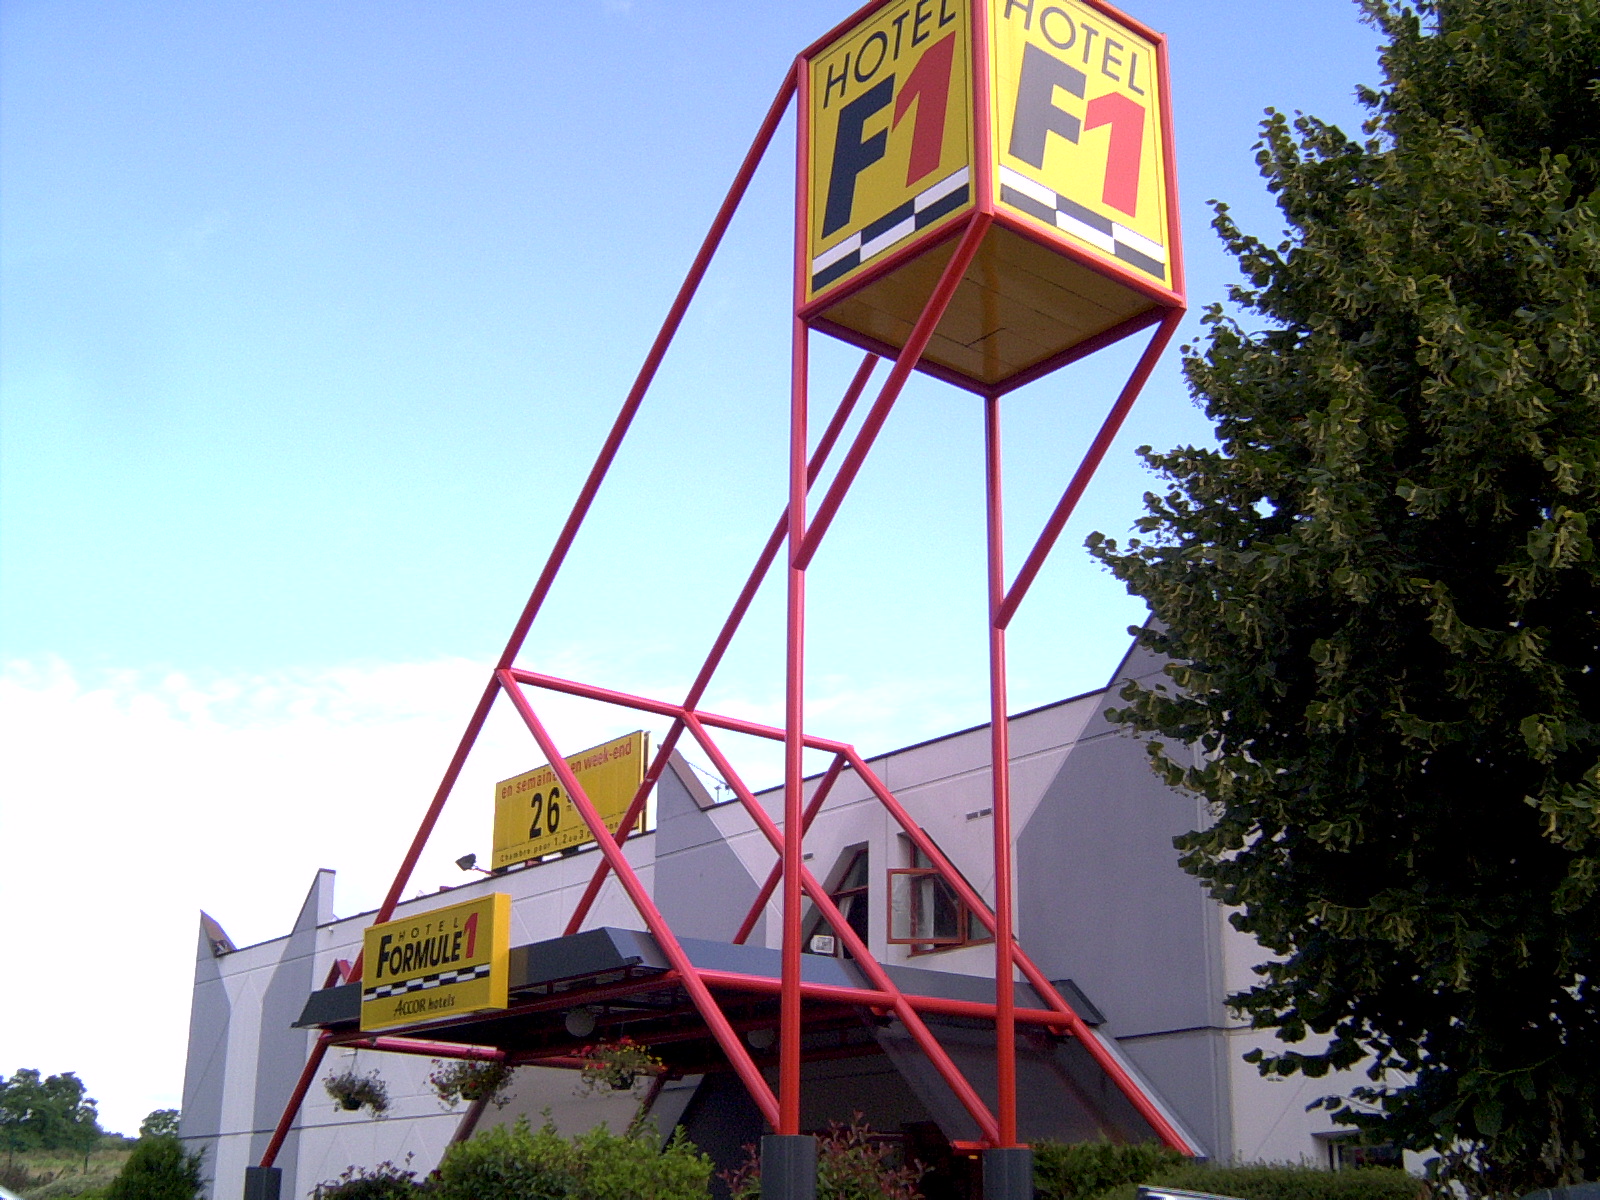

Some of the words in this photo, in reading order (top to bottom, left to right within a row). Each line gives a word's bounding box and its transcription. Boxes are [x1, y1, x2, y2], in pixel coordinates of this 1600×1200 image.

[823, 0, 956, 109] HOTEL
[1003, 0, 1146, 96] HOTEL
[821, 31, 956, 240] F1
[1008, 41, 1146, 218] F1
[501, 784, 513, 799] en
[570, 760, 582, 775] en
[584, 737, 632, 769] week-end
[529, 786, 560, 839] 26
[376, 931, 463, 979] FORMULE
[463, 912, 479, 959] 1
[397, 917, 459, 942] HOTEL
[428, 993, 456, 1010] hotels
